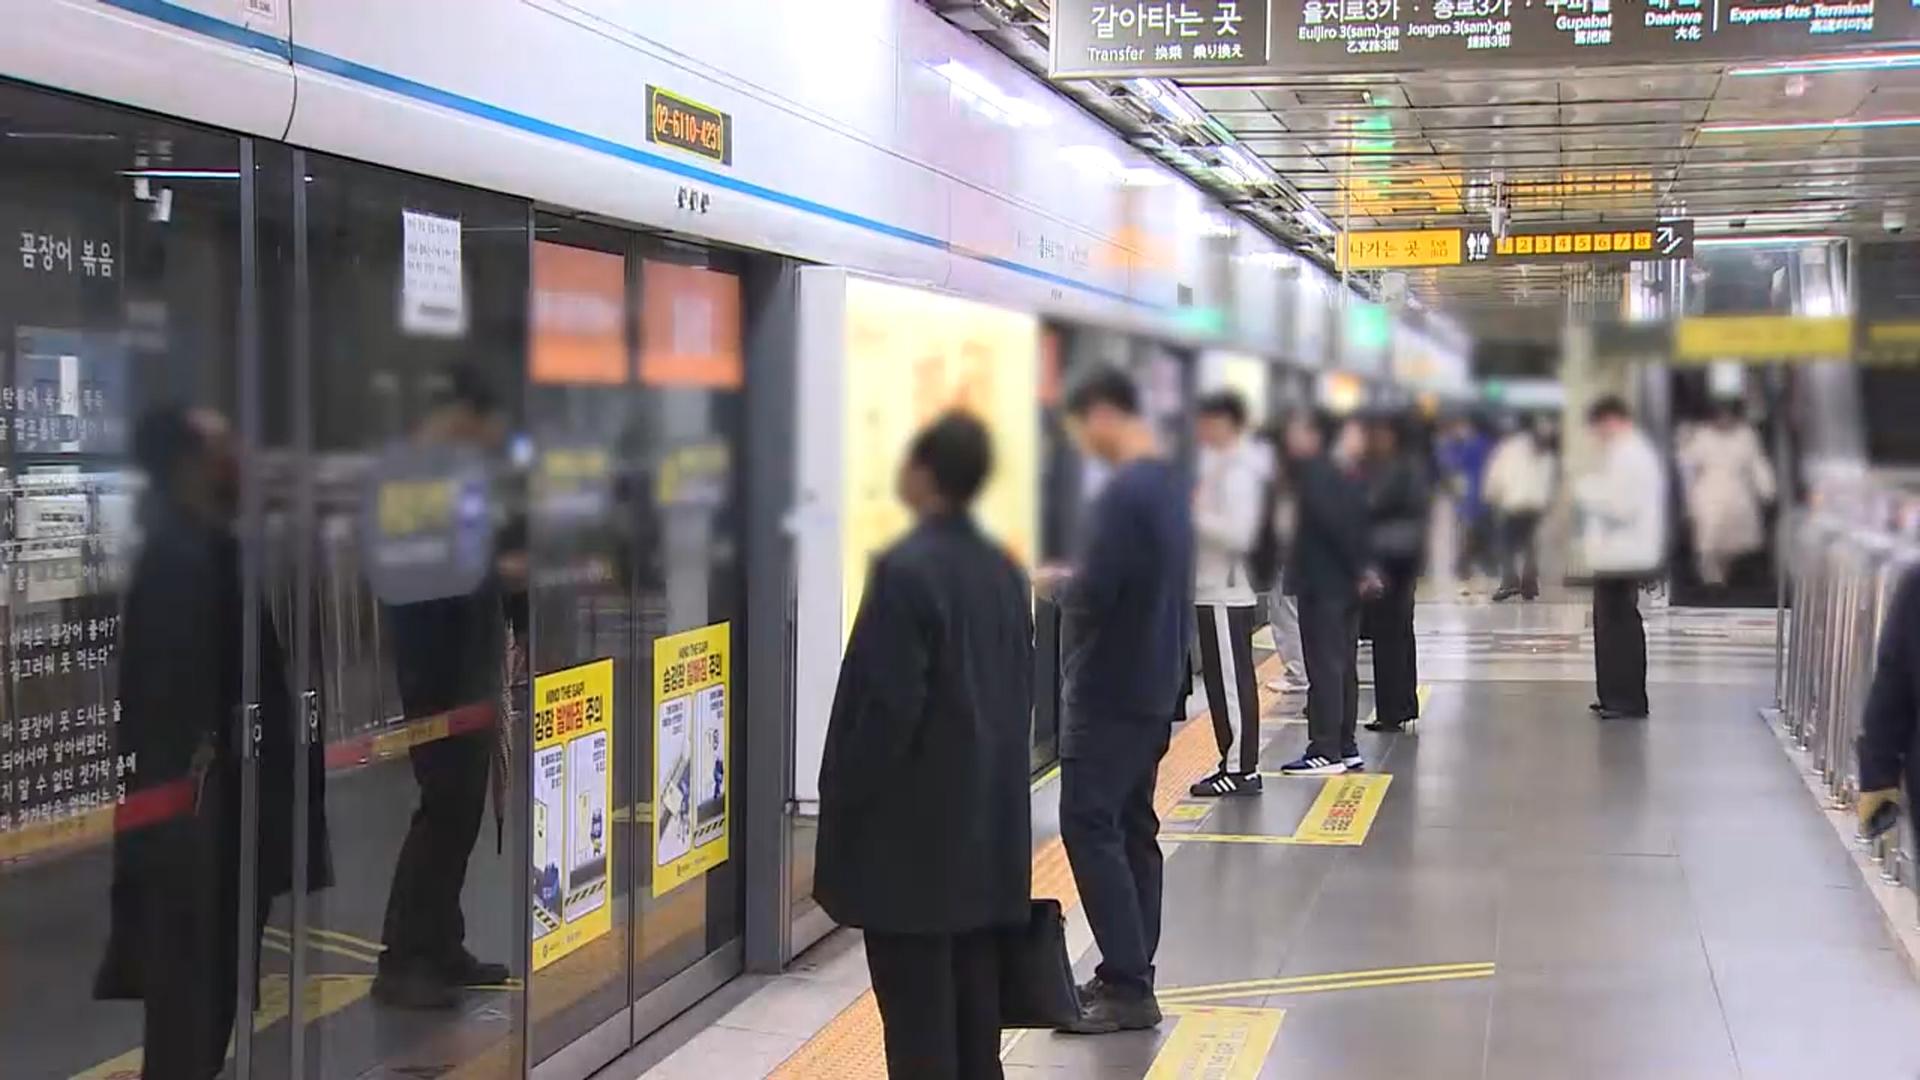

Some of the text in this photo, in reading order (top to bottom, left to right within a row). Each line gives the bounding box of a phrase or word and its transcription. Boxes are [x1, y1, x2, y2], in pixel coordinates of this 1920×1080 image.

[1091, 2, 1243, 39] 갈아타는 곳
[1302, 0, 1401, 24] 을지로3가
[1556, 14, 1612, 31] Gupabal
[1645, 11, 1702, 26] Daehwa
[1730, 1, 1874, 24] Express Bus Terminal
[1339, 25, 1400, 41] 3(sam)-ga
[1407, 19, 1512, 38] Jongno 3(sam)-ga
[1675, 25, 1701, 41] 大化
[1088, 45, 1146, 62] Transfer
[655, 103, 721, 152] 02-6110-4231
[1350, 239, 1419, 259] 나가는 곳
[1519, 238, 1528, 249] 2
[1541, 238, 1548, 249] 3
[1559, 237, 1567, 249] 4
[1579, 237, 1586, 248] 5
[1598, 236, 1607, 248] 6
[1618, 236, 1627, 248] 7
[1638, 236, 1647, 247] 8
[81, 239, 114, 277] 볶음
[60, 651, 72, 673] 못
[709, 648, 722, 680] 주의
[59, 709, 71, 733] 못
[75, 703, 108, 726] 드시는
[586, 694, 603, 727] 주의
[53, 730, 112, 763] 알아버렸다.
[18, 775, 30, 802] 알
[36, 773, 48, 796] 수
